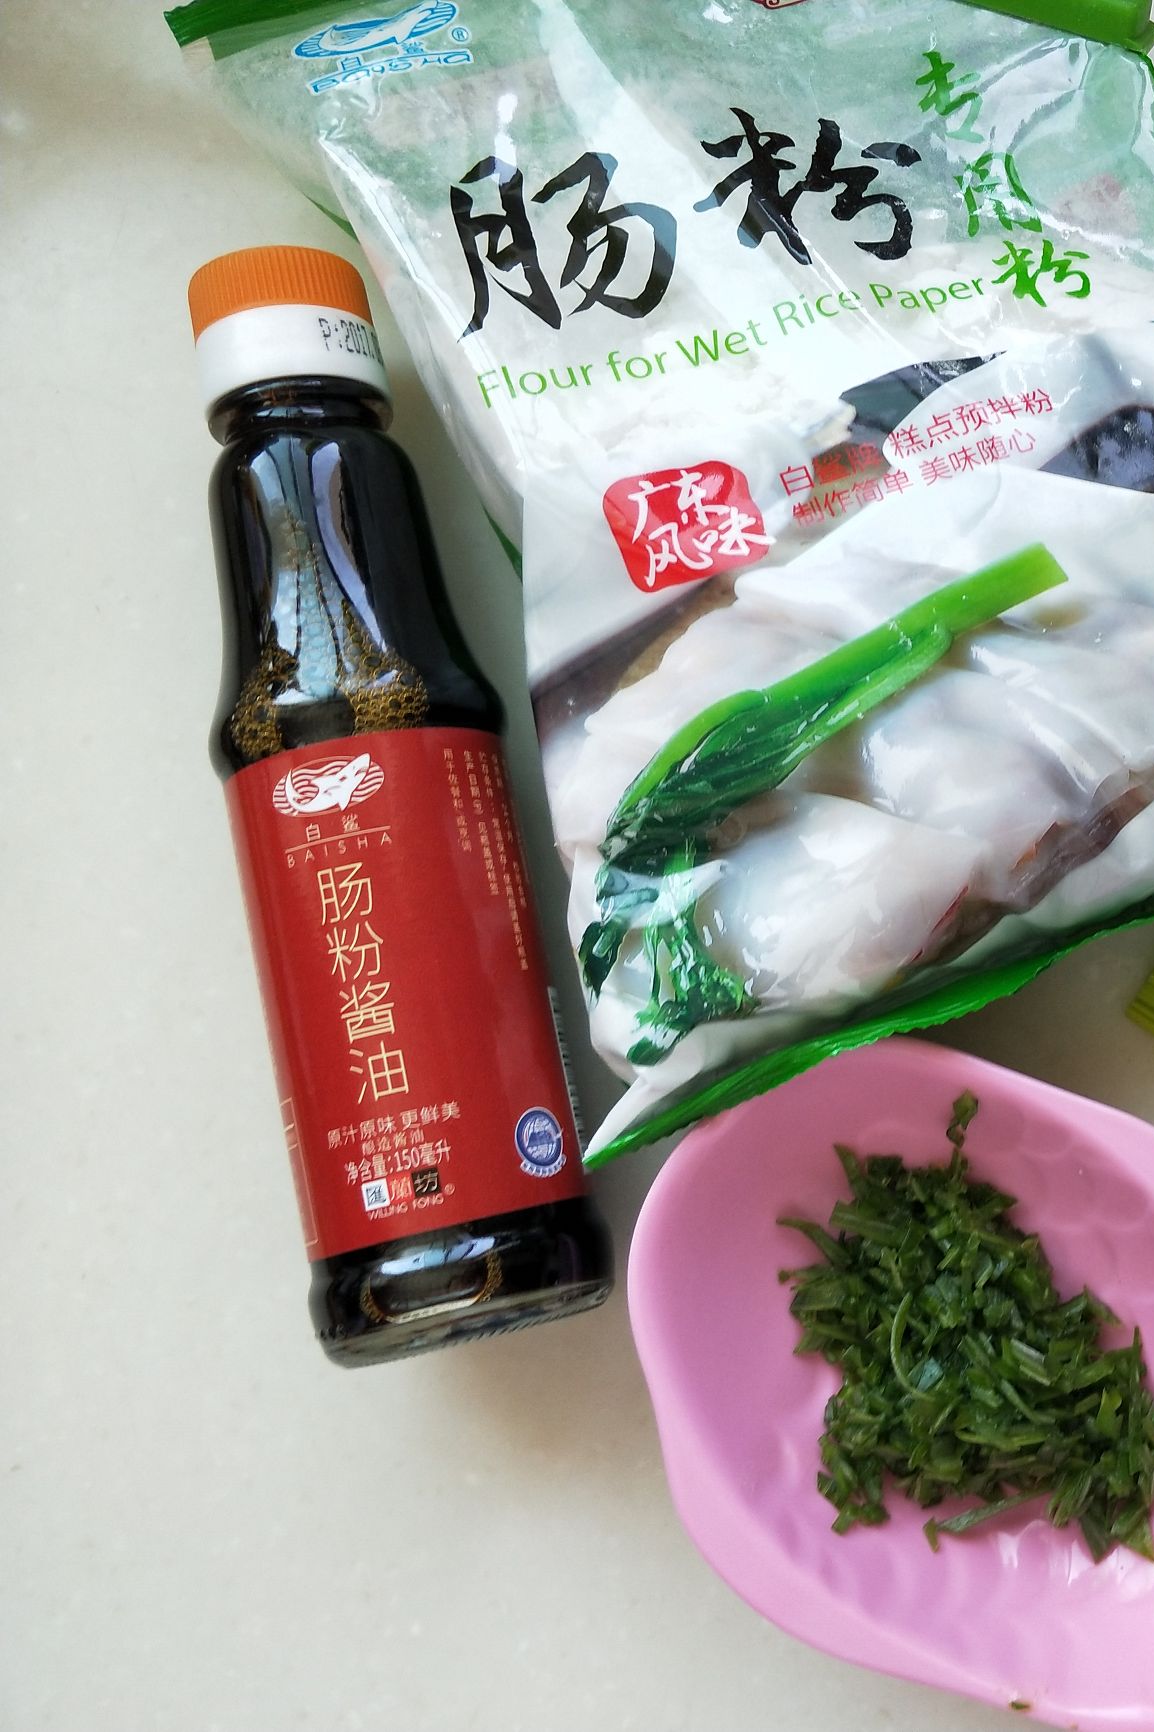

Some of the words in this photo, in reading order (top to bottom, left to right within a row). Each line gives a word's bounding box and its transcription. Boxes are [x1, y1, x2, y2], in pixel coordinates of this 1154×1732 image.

[451, 107, 922, 344] 肠粉
[477, 361, 594, 408] Flour
[607, 349, 667, 384] for
[676, 319, 768, 367] Wet
[773, 289, 861, 337] Rice
[869, 276, 985, 314] Paper
[887, 388, 1055, 459] 糕点预拌粉
[628, 470, 731, 544] 广东
[792, 469, 914, 527] 制作简单
[918, 428, 1036, 487] 美味随心
[643, 507, 777, 587] 风味
[286, 831, 392, 869] BAISHA
[316, 861, 410, 1105] 肠粉酱油
[327, 1114, 397, 1150] 原汁原味
[400, 1099, 461, 1131] 更鲜美
